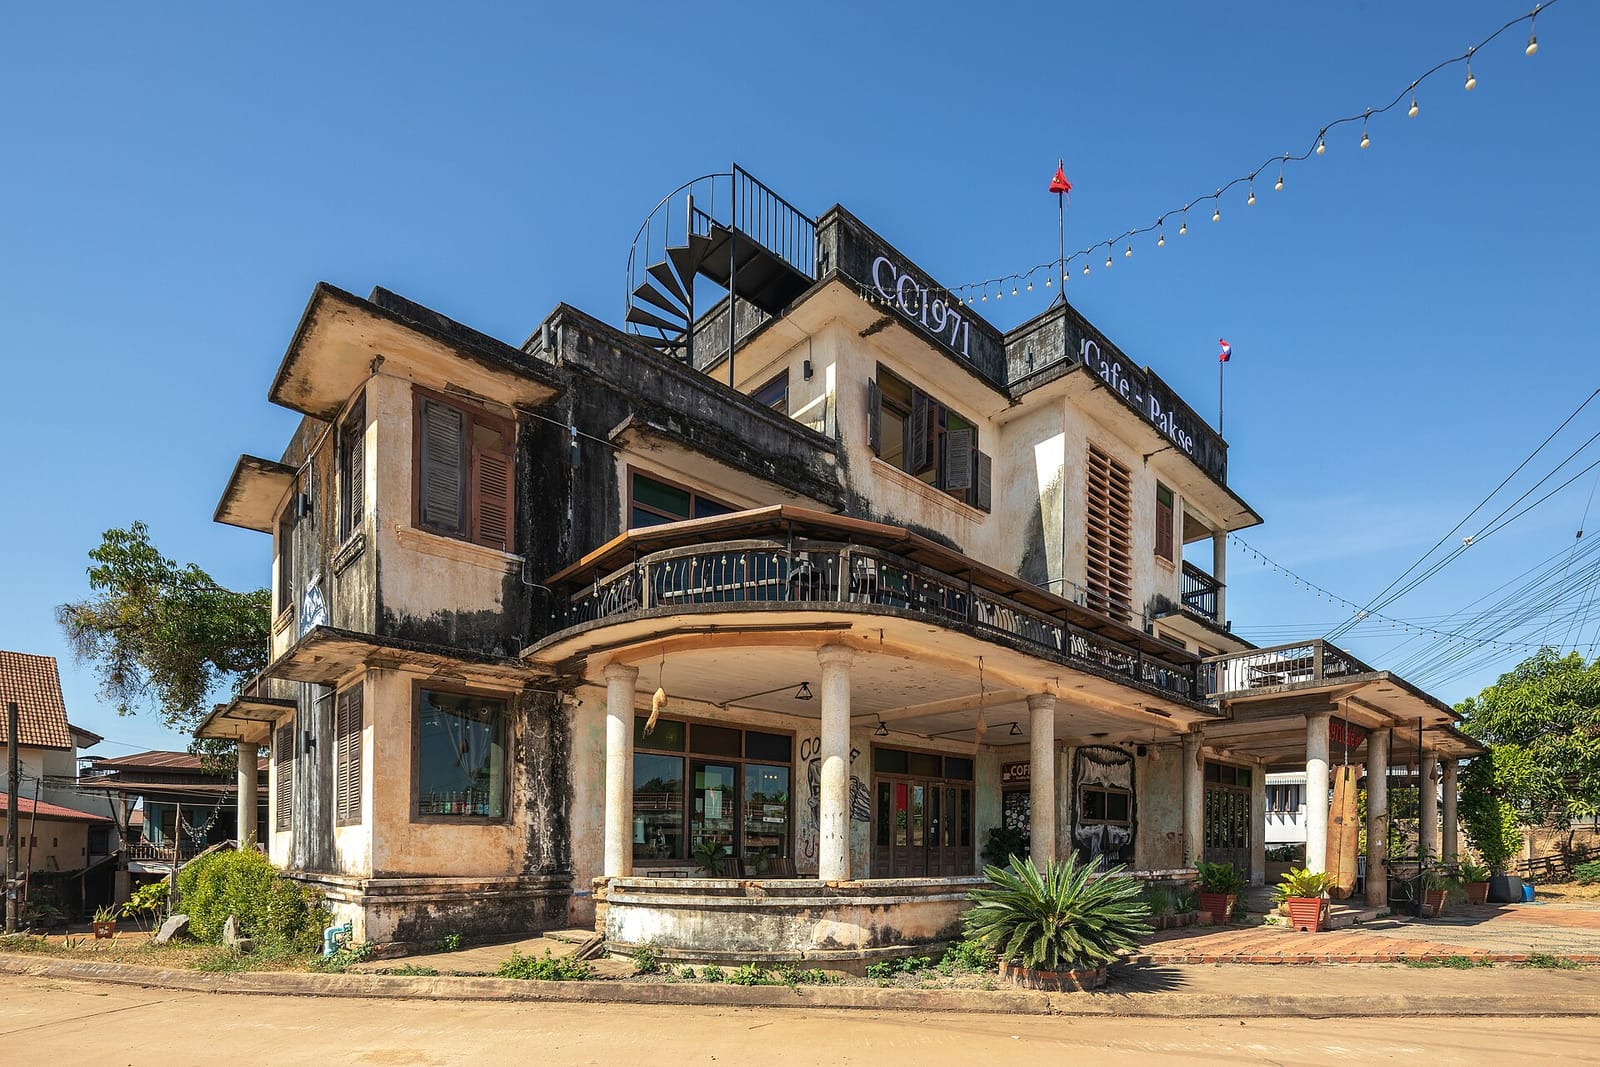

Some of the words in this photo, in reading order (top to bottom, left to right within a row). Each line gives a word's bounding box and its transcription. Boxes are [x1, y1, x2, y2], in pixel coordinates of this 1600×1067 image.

[872, 256, 970, 358] CC1971
[1084, 340, 1130, 400] Cafe
[1149, 394, 1193, 455] Pakse
